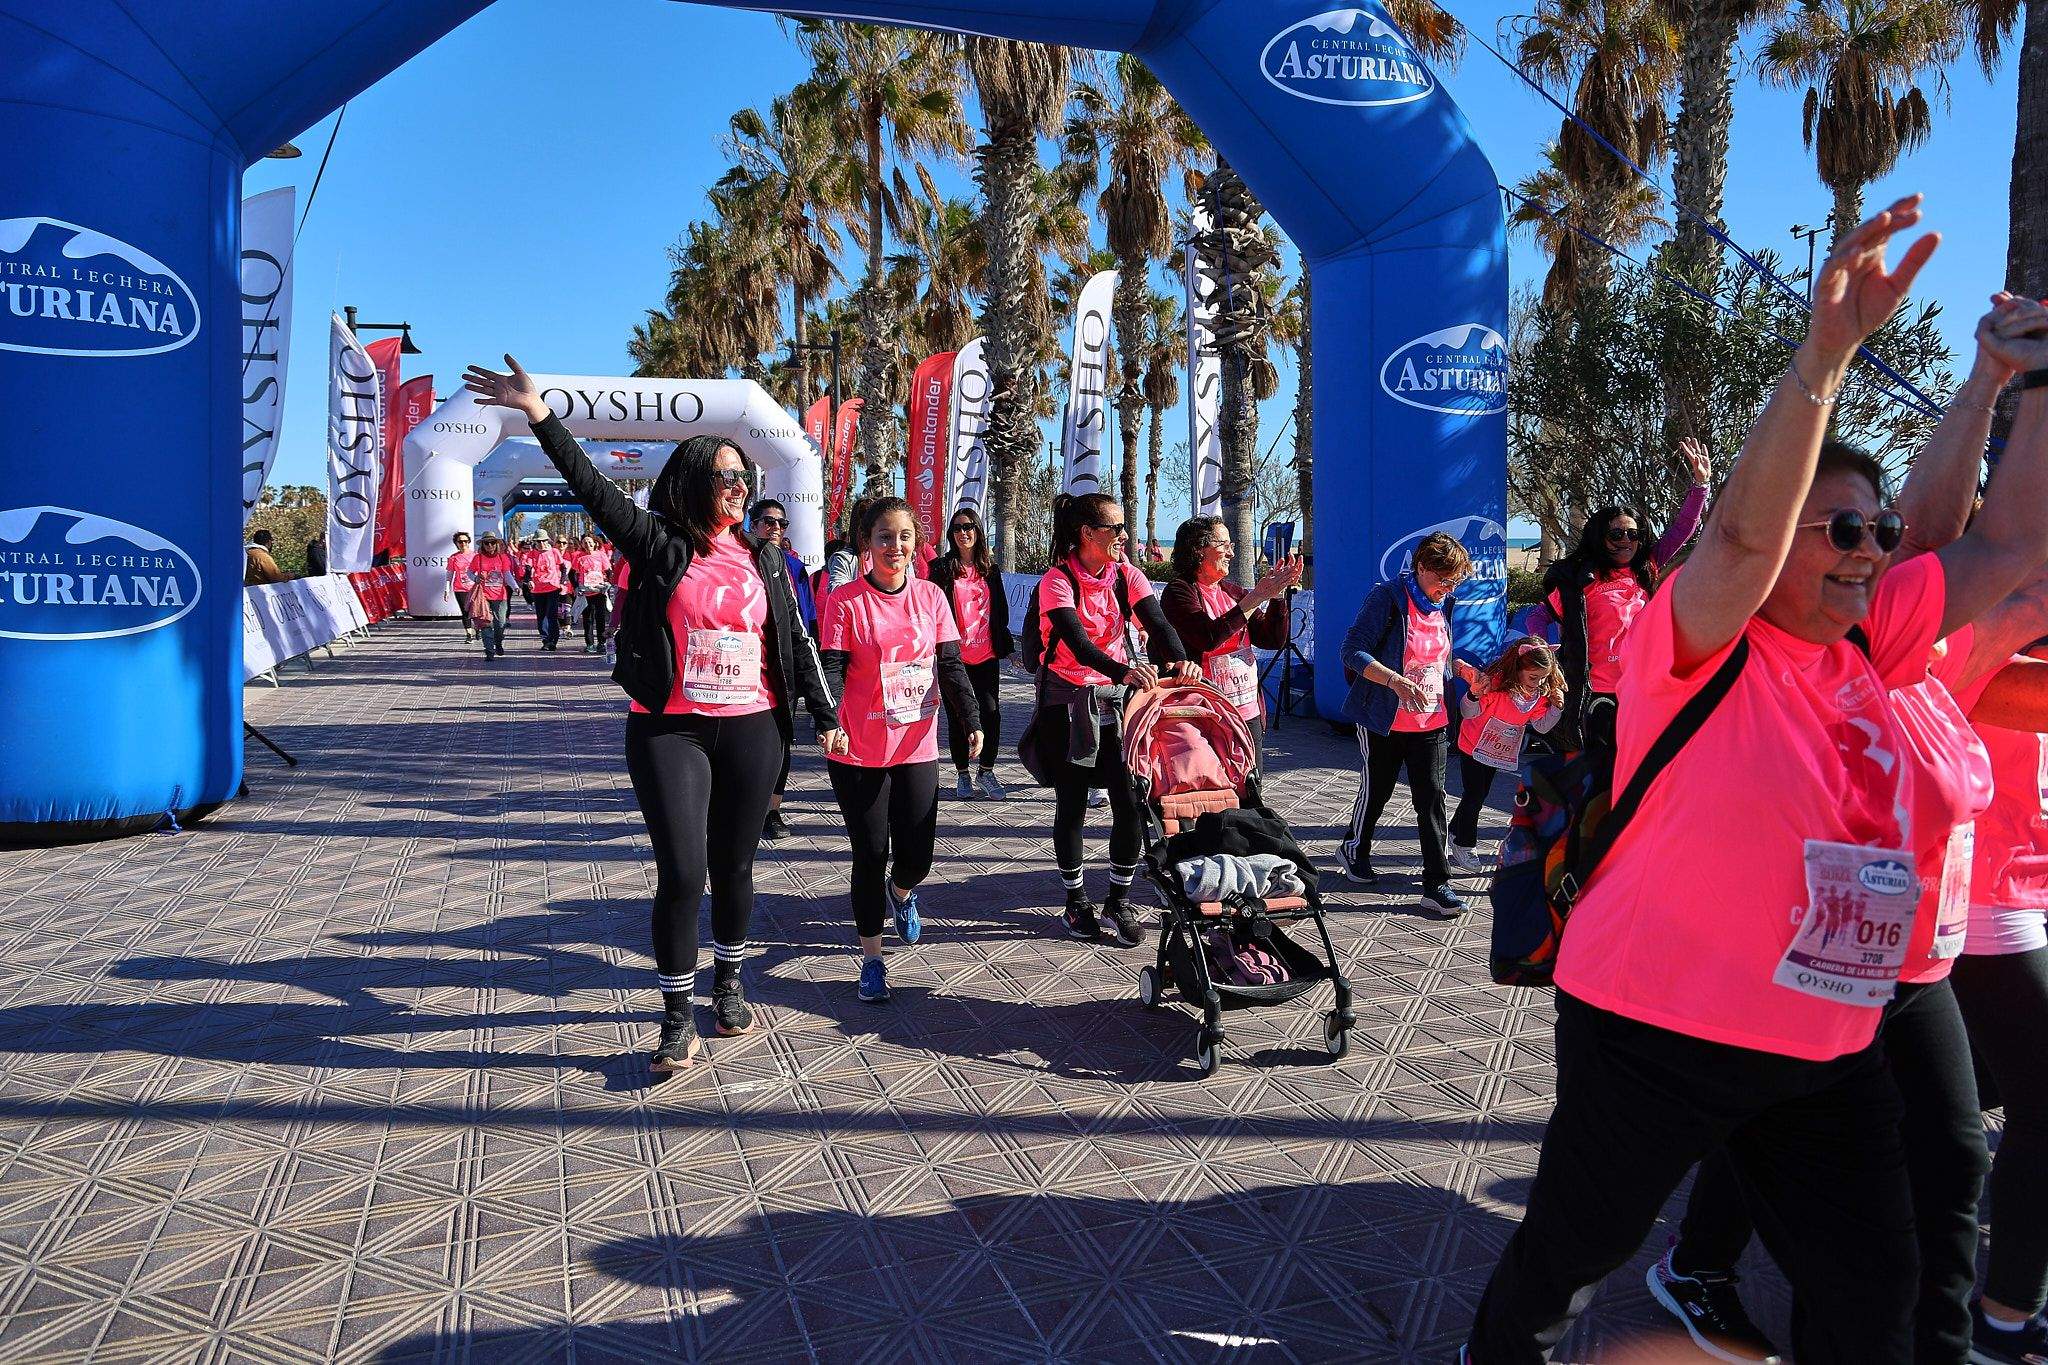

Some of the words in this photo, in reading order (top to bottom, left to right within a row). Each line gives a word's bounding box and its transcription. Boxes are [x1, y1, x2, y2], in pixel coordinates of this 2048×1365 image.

[1312, 39, 1370, 51] CENTRAL
[1275, 41, 1429, 87] ASTURIANA
[73, 268, 174, 297] LECHERA
[0, 280, 184, 336] URIANA
[1426, 355, 1480, 364] CENTRAL
[539, 387, 704, 423] OYSHO
[433, 421, 487, 435] OYSHO
[920, 377, 942, 466] Santander
[335, 345, 375, 529] OYSHO
[750, 428, 796, 439] OYSHO
[836, 416, 852, 483] Santander
[411, 488, 461, 501] OYSHO
[776, 492, 819, 503] OYSHO
[76, 554, 175, 569] LECHERA
[412, 556, 449, 567] OYSH
[714, 663, 741, 676] 016
[1231, 673, 1249, 685] 016
[904, 685, 924, 698] 016
[1419, 683, 1434, 693] 016
[691, 691, 718, 700] OYSHO
[1493, 742, 1511, 752] 016
[1857, 920, 1901, 947] 016
[1860, 951, 1884, 965] 3708
[1809, 959, 1845, 975] CARRERA
[1846, 966, 1856, 975] DE
[1797, 972, 1854, 995] OYSHO
